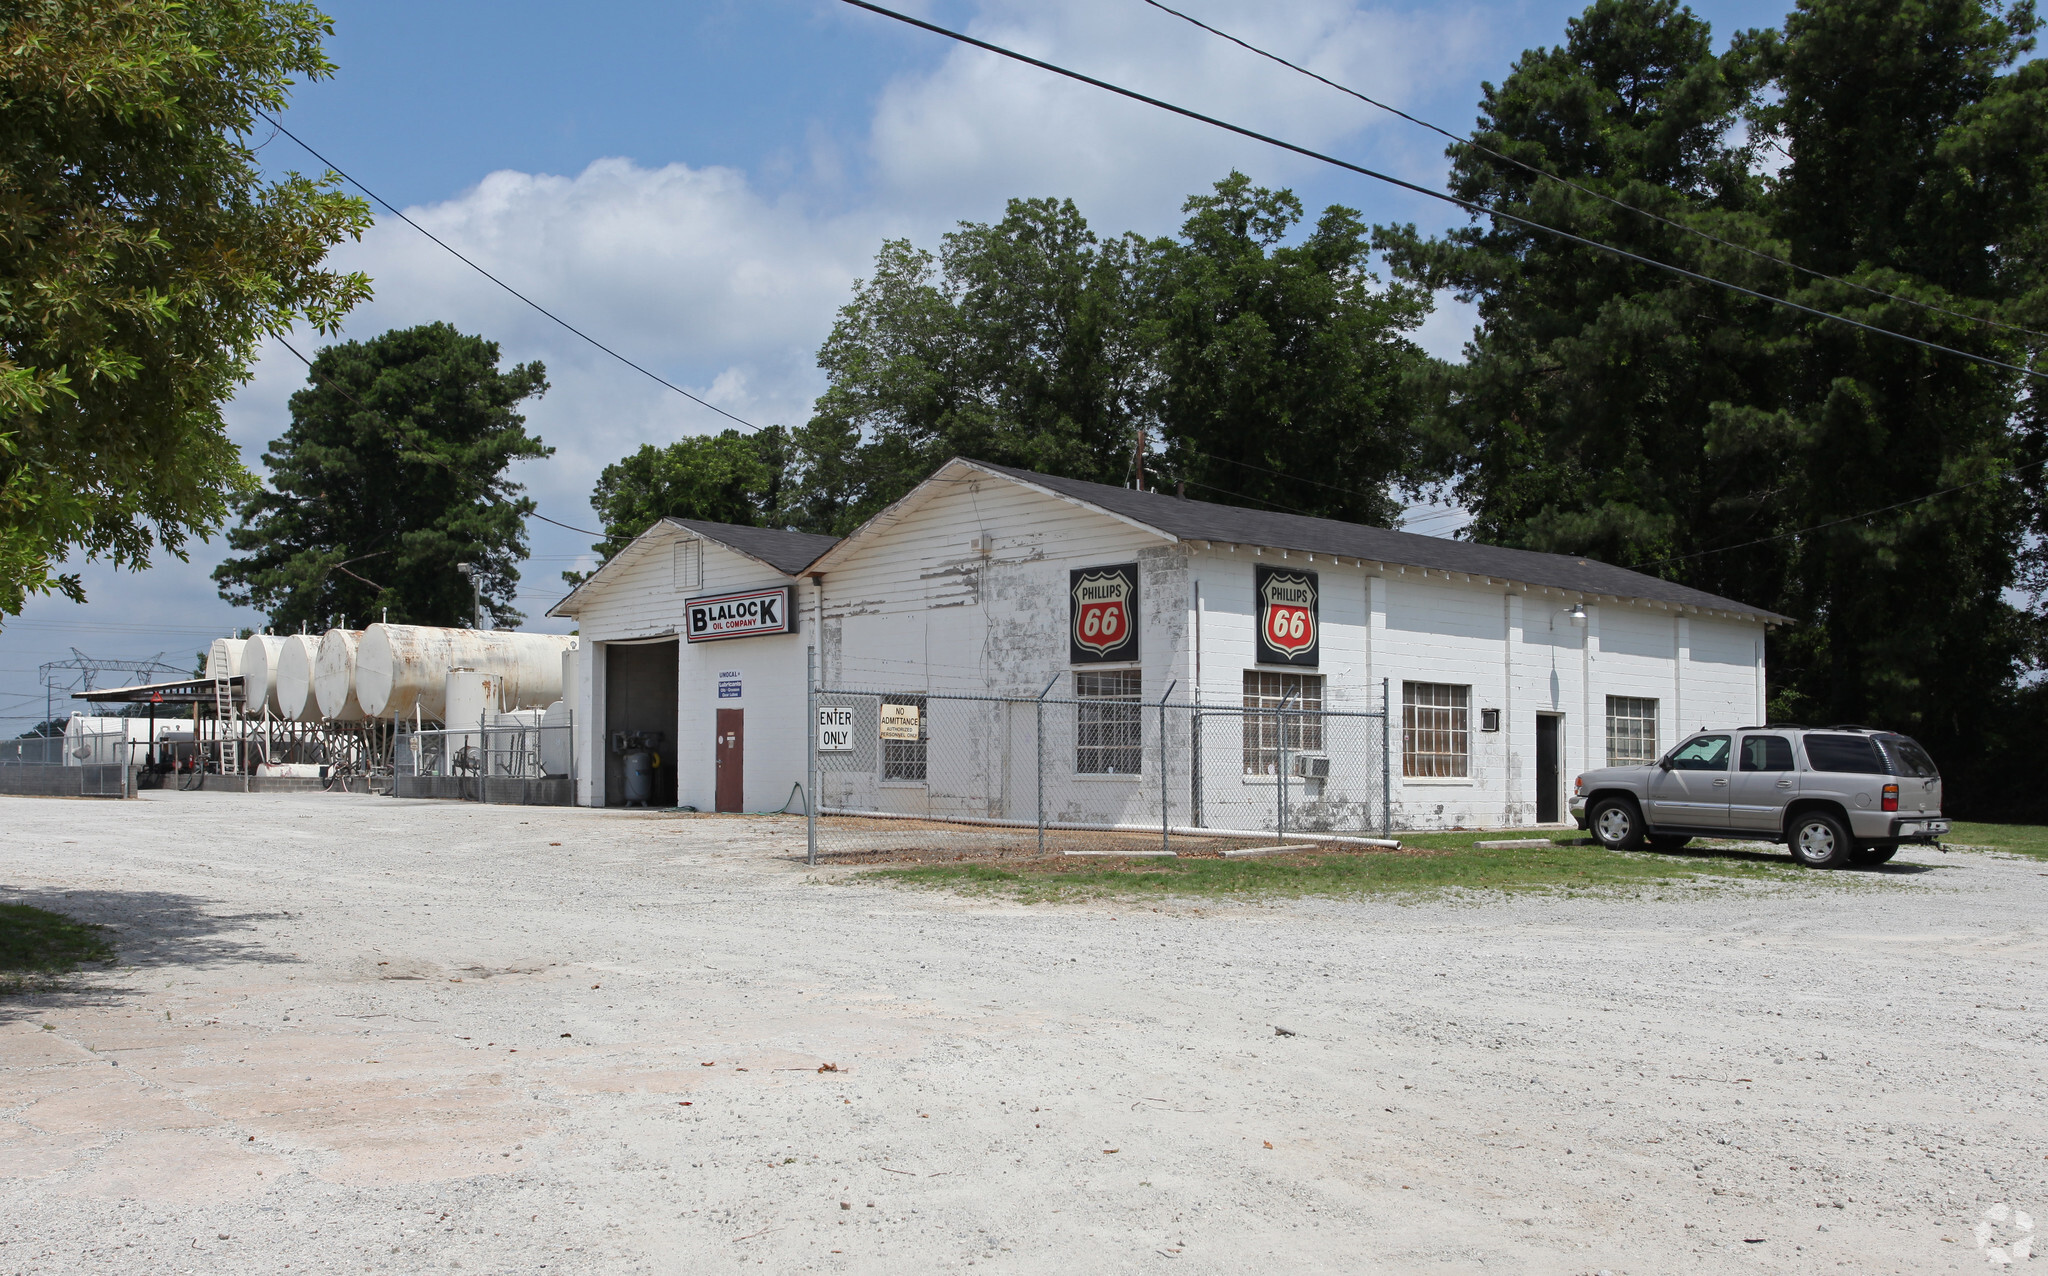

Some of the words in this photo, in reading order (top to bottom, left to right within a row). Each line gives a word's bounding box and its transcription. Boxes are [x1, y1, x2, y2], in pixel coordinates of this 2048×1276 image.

[1082, 584, 1122, 600] PHILLIPS
[1271, 586, 1308, 603] PHILLIPS
[692, 599, 778, 632] BLALOCK
[1084, 606, 1120, 637] 66
[713, 622, 723, 630] OIL
[726, 619, 757, 629] COMPANY
[1273, 609, 1306, 639] 66
[820, 711, 852, 725] ENTER
[882, 717, 918, 725] ADMITTANCE
[823, 731, 848, 745] ONLY
